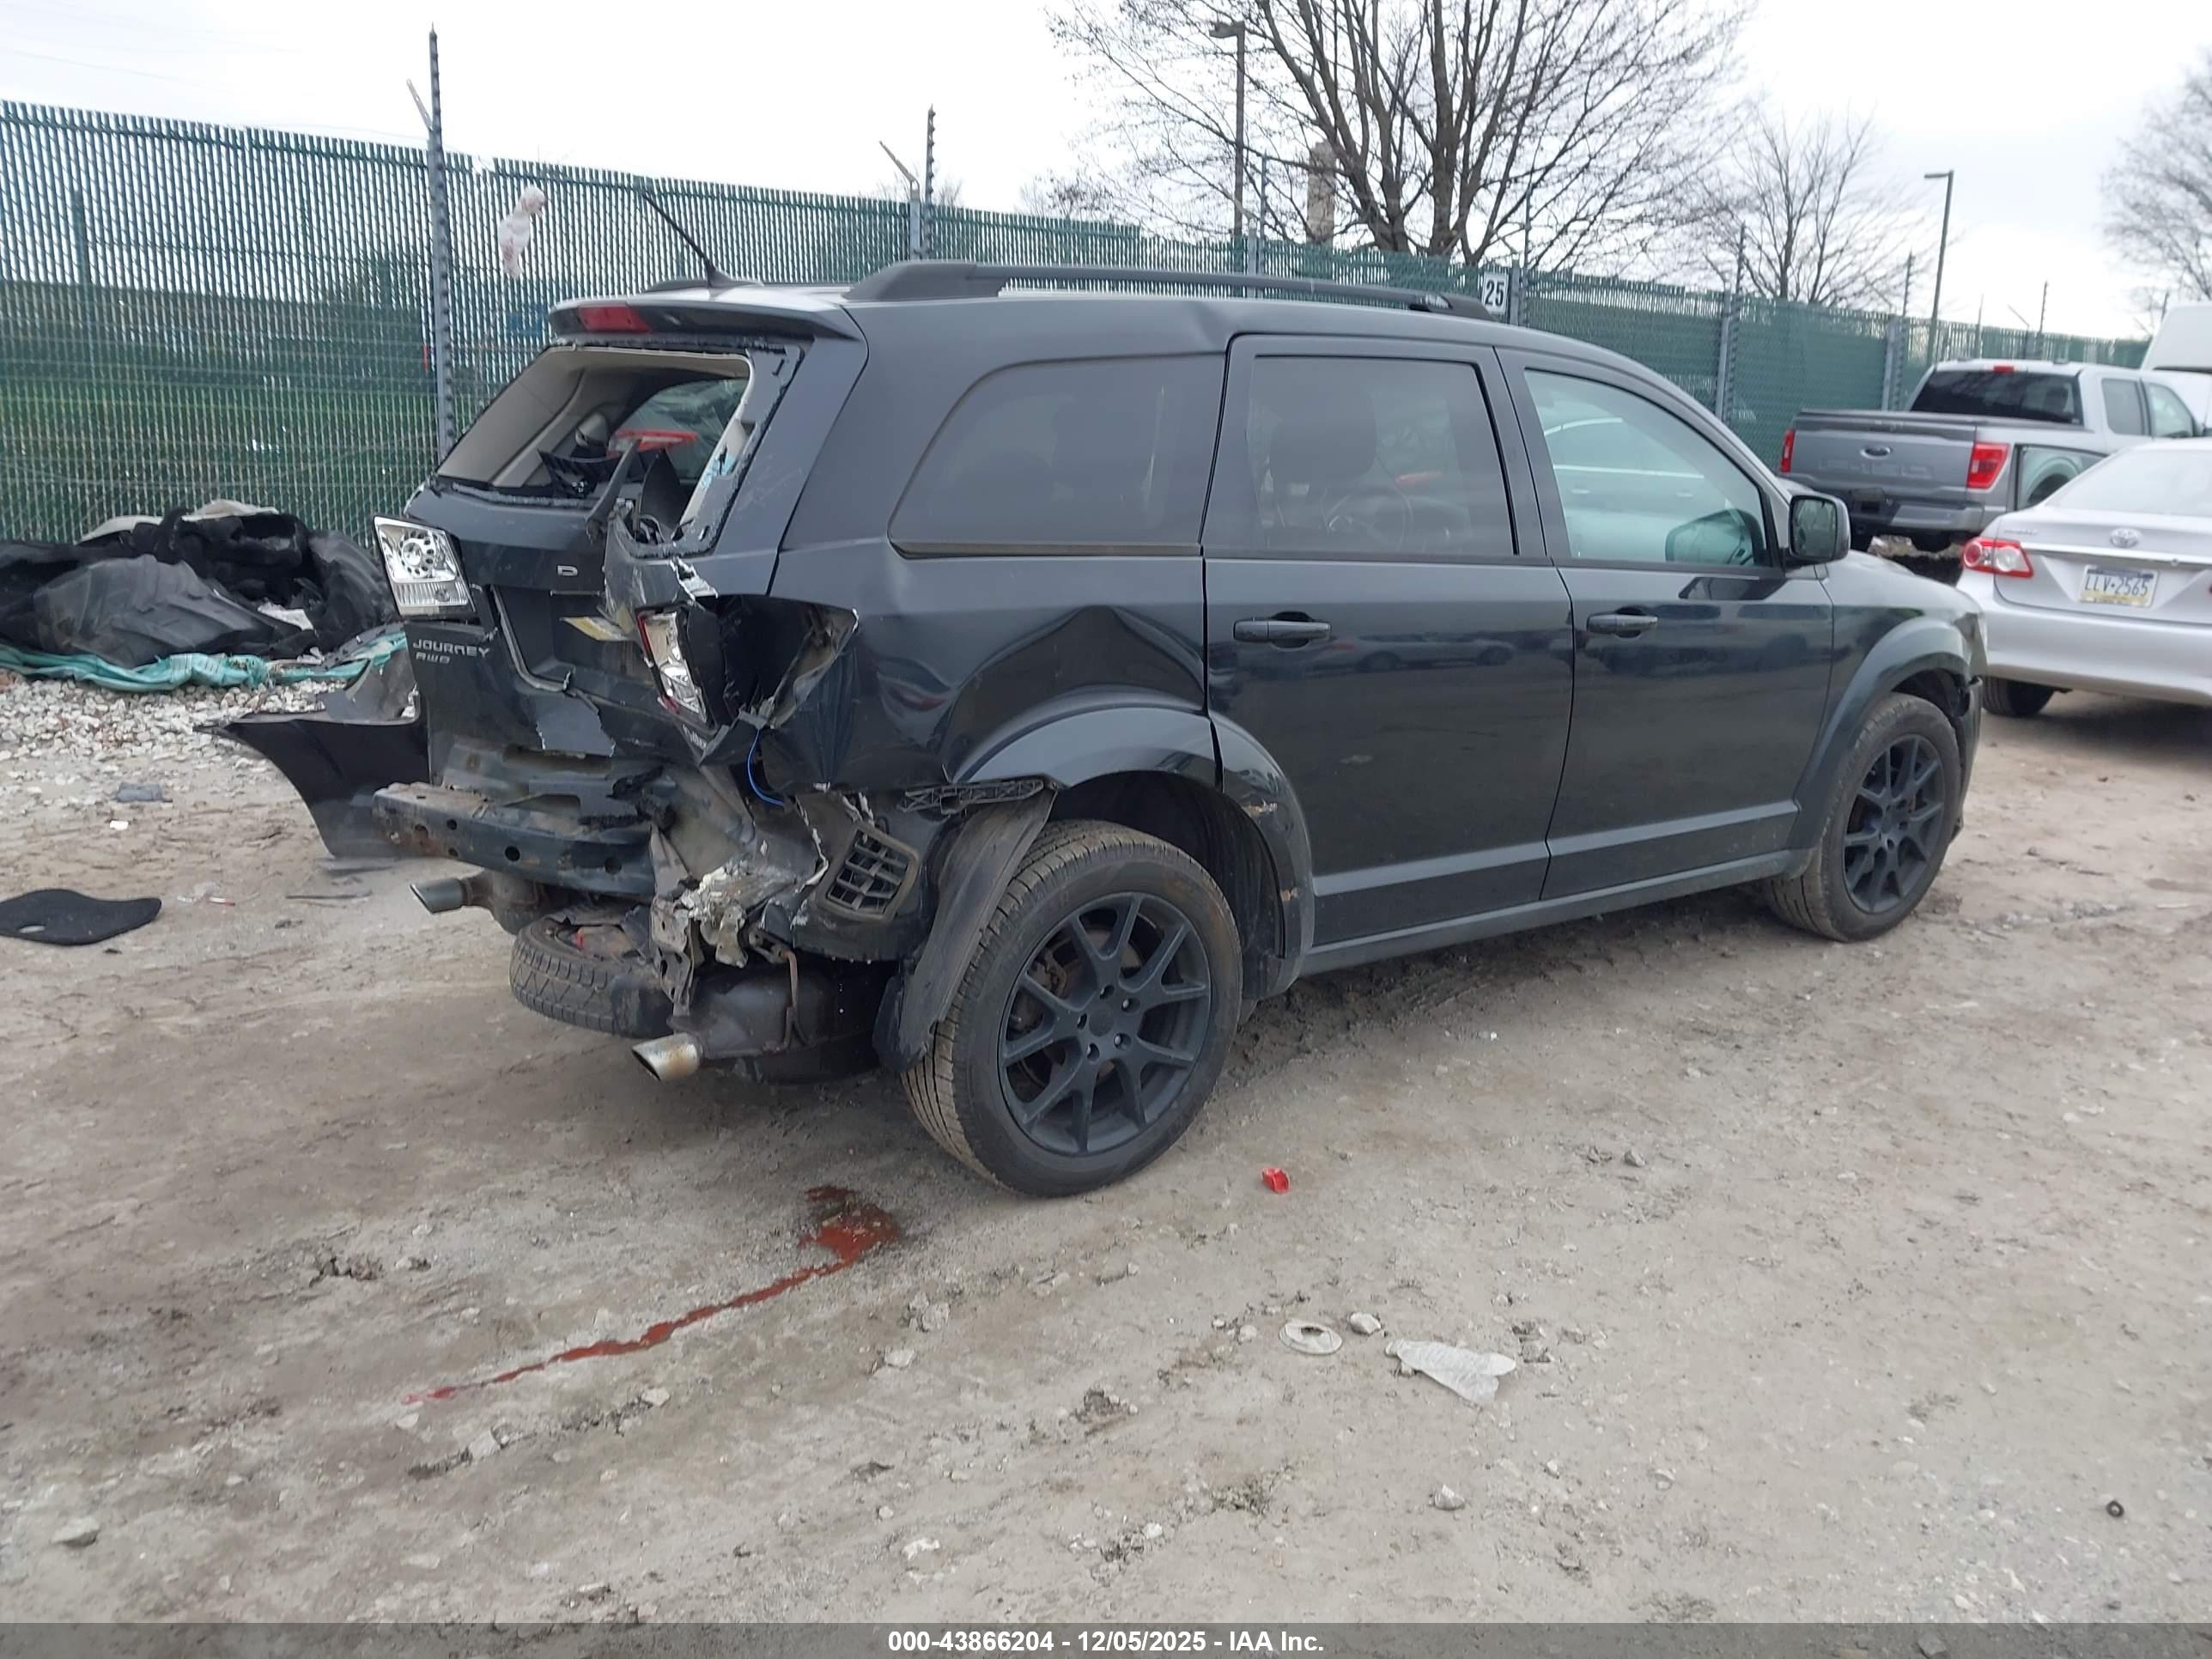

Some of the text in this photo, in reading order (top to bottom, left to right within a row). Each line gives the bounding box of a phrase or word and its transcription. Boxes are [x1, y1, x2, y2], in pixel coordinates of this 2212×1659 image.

[1485, 280, 1504, 307] 25
[557, 565, 578, 576] D
[412, 639, 490, 658] JOURNEY
[416, 651, 451, 665] AWD
